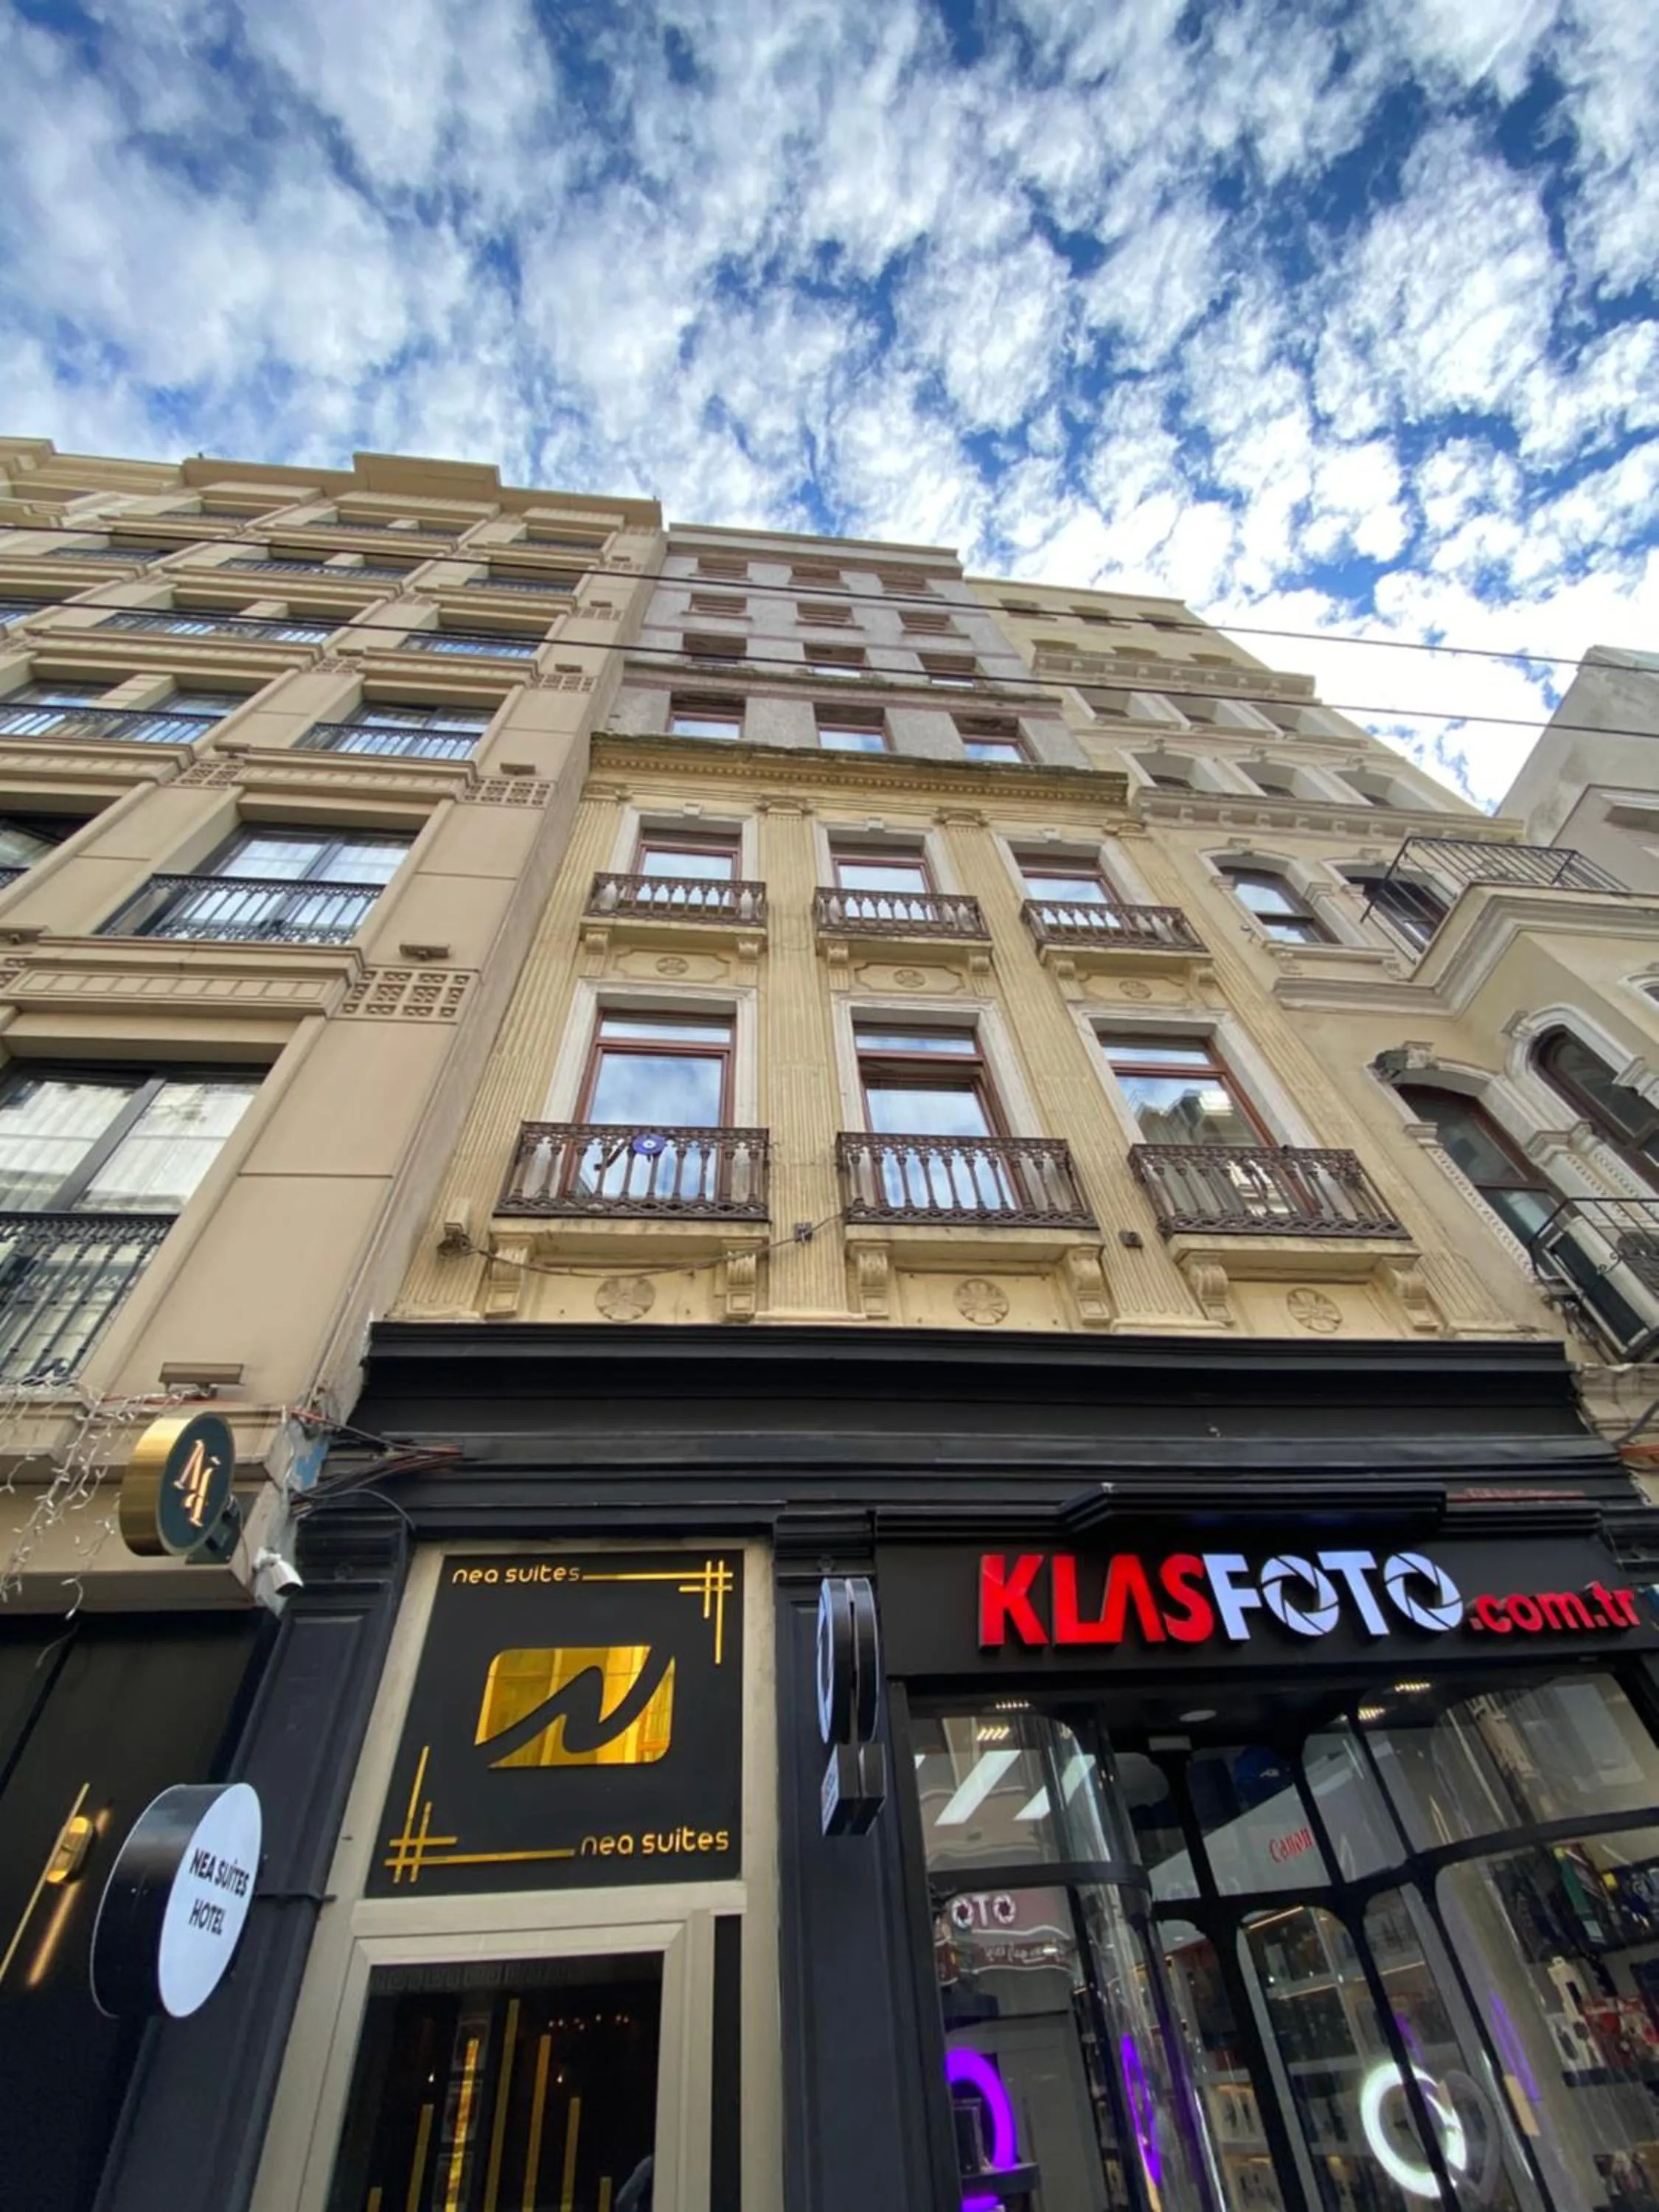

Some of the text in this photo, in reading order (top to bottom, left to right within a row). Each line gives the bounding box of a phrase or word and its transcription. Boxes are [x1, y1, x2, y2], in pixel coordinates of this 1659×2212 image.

[452, 1563, 580, 1584] nea suites
[580, 1826, 729, 1856] nea suites
[189, 1847, 216, 1882] NEA
[188, 1899, 226, 1935] HOTEL
